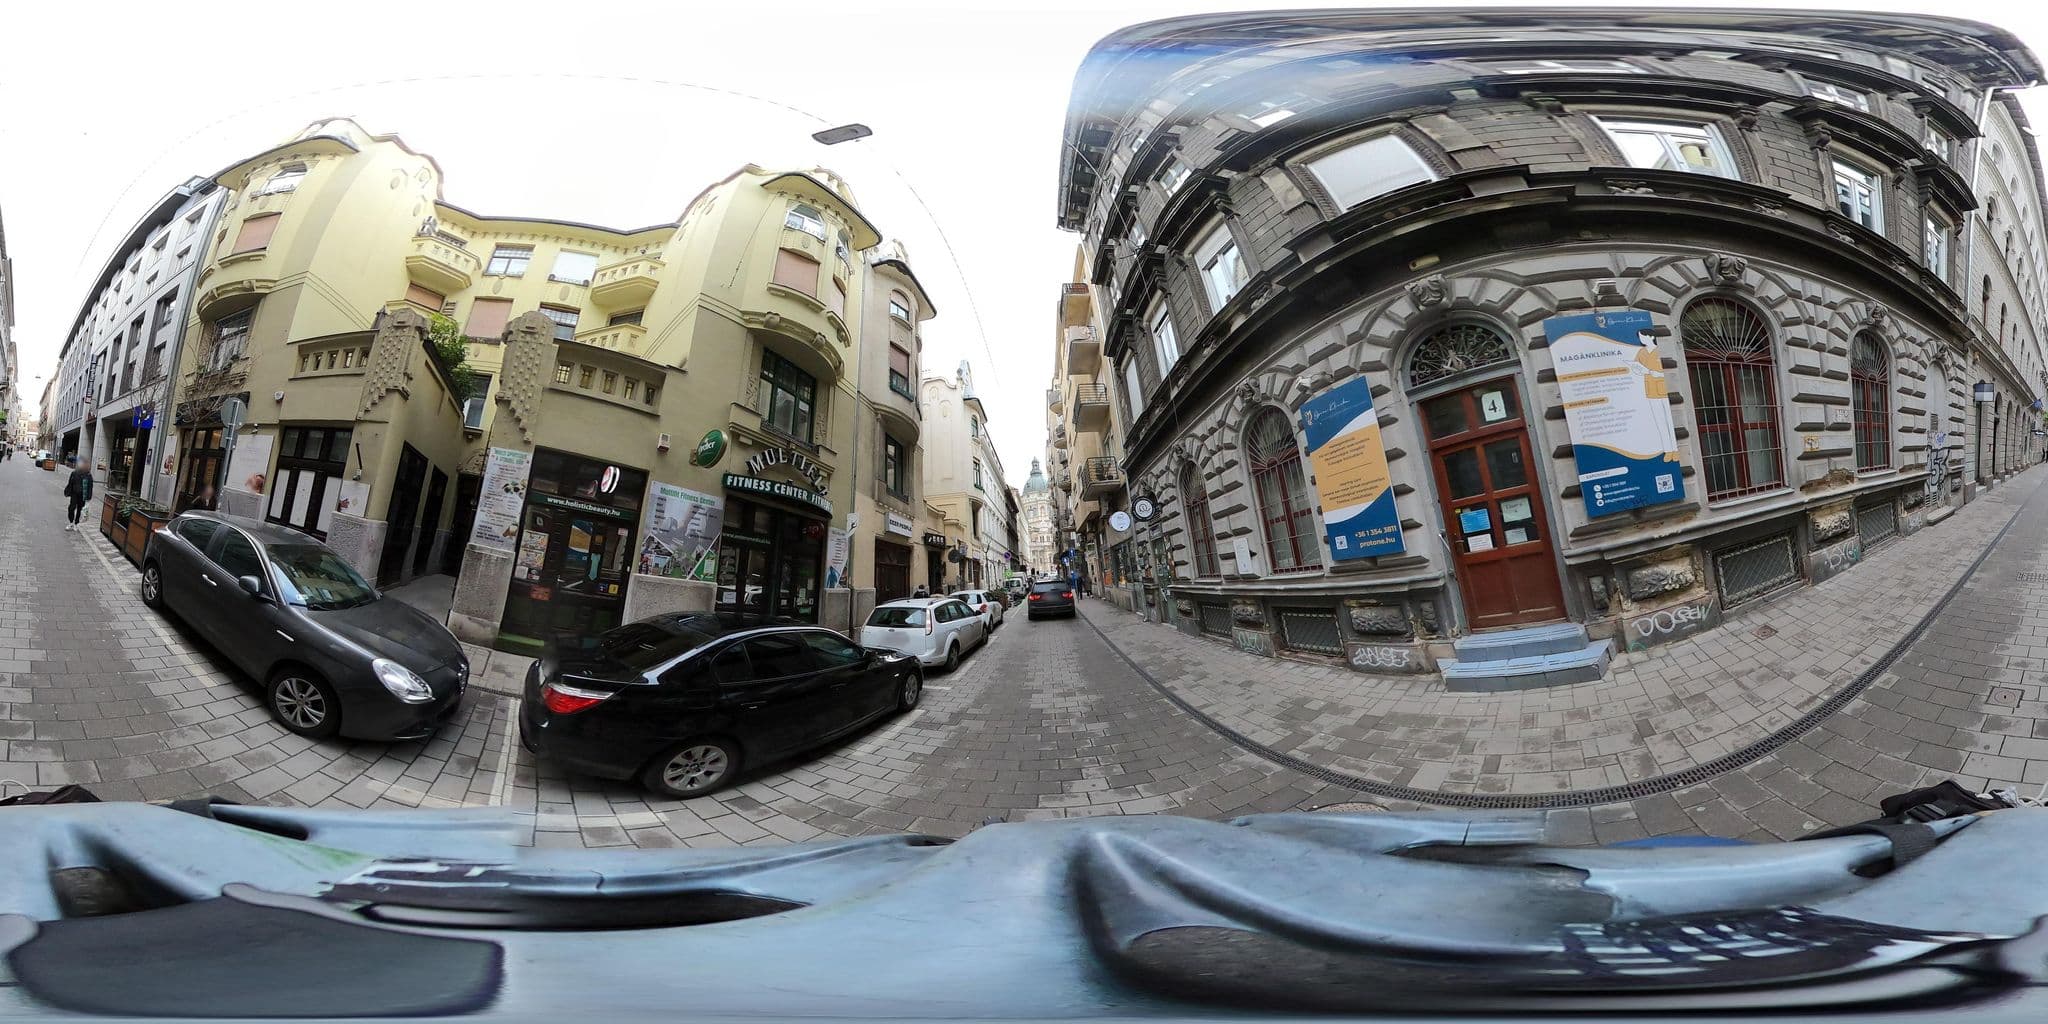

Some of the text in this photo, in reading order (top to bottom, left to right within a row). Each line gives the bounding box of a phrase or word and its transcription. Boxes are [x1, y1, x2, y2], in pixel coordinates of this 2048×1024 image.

[1559, 350, 1623, 363] MAGÁNKLINIKA
[726, 475, 772, 492] FITNESS
[774, 483, 808, 500] CENTER
[546, 496, 621, 517] www.holisticbeauty.hu
[1359, 537, 1396, 549] protone.hu
